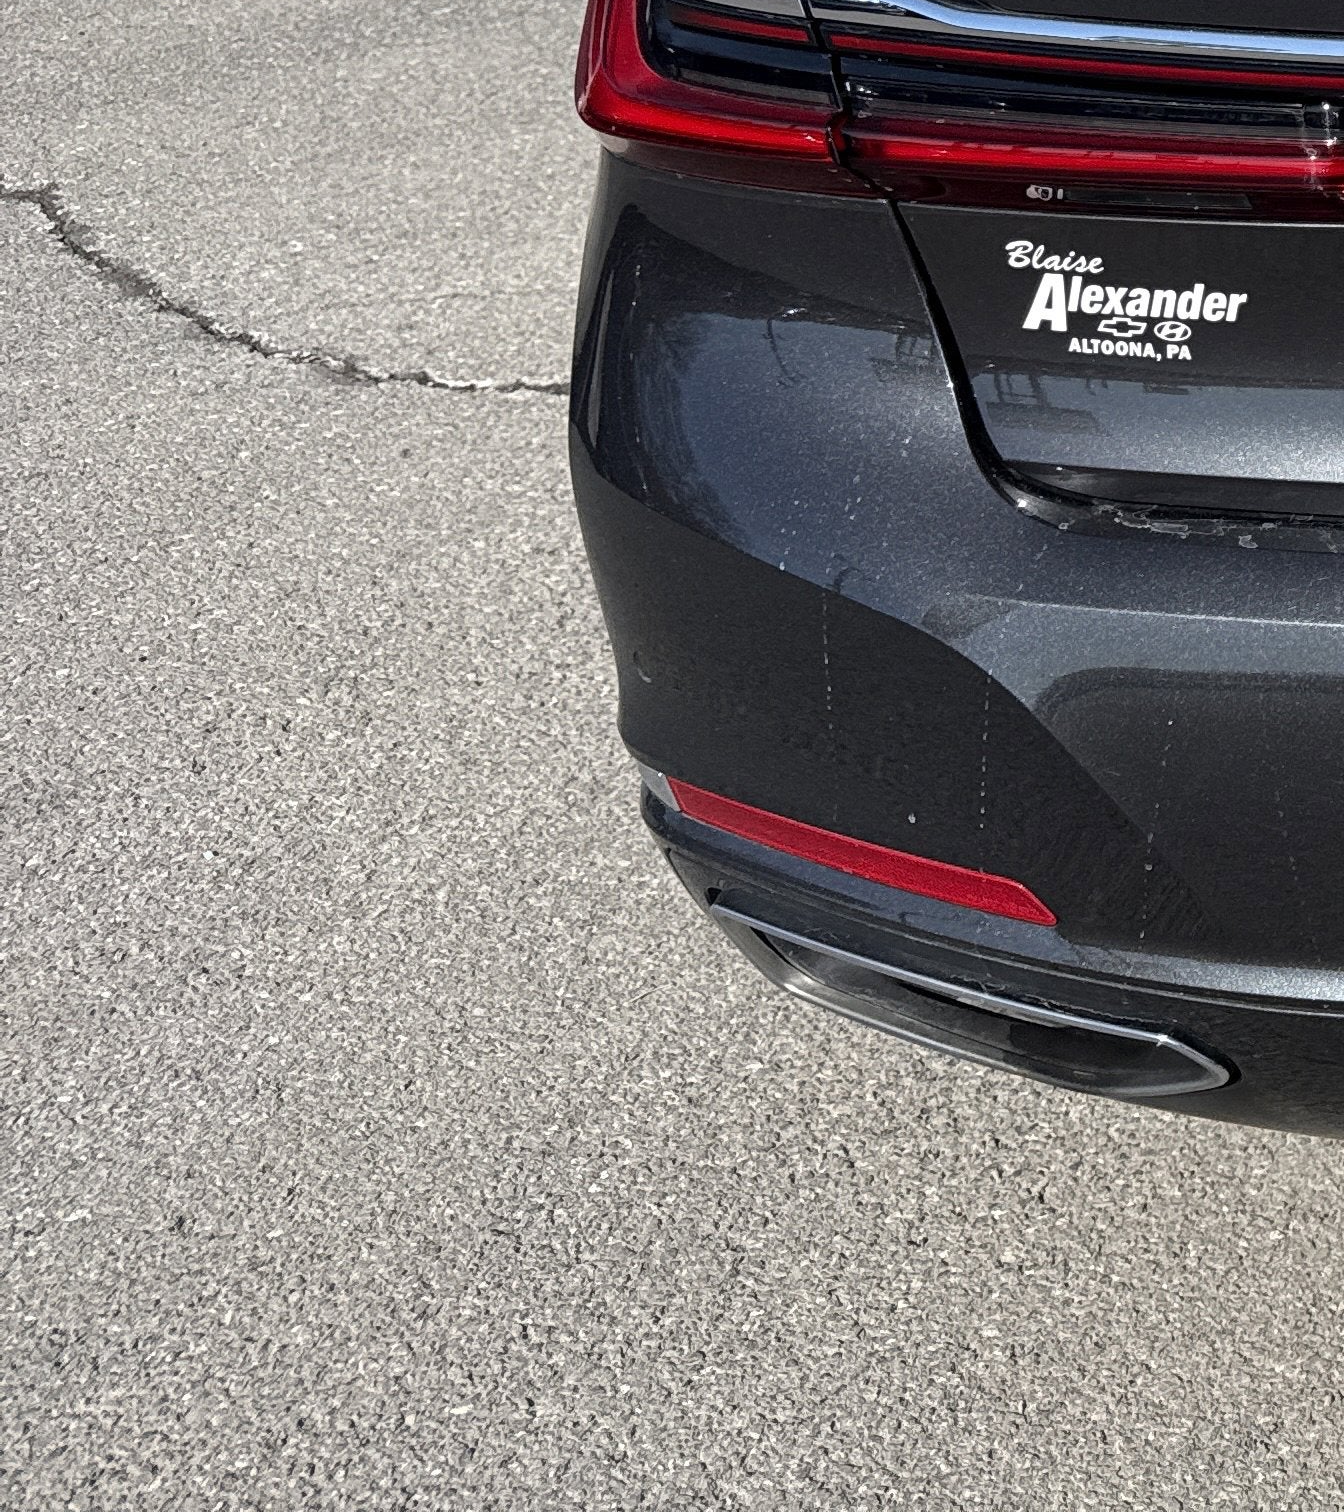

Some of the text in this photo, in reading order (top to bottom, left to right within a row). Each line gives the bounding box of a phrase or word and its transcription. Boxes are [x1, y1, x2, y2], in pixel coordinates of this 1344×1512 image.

[1005, 240, 1104, 274] Blaise
[1021, 272, 1248, 332] Alexander
[1068, 337, 1192, 362] ALTOONA, PA
